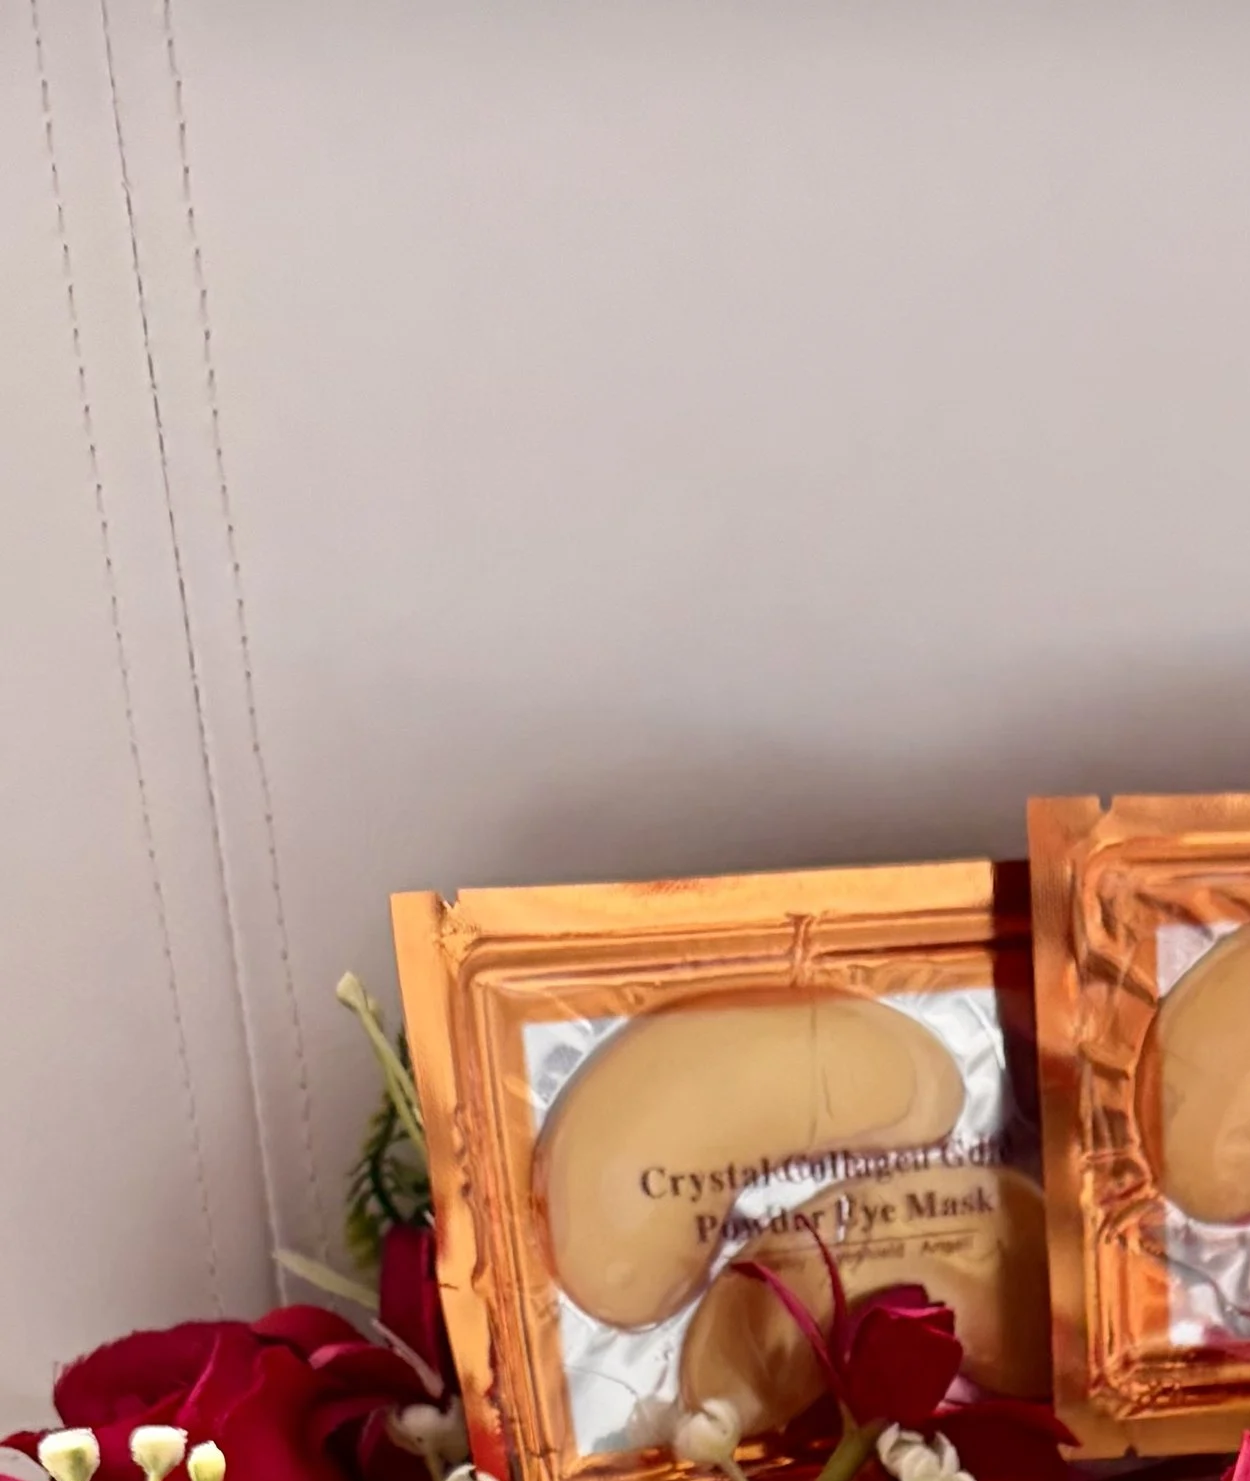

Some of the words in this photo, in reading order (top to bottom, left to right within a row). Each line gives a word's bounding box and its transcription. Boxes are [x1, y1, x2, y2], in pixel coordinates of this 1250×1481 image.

[641, 1156, 771, 1202] Crystal
[782, 1148, 930, 1184] Collagen
[906, 1187, 993, 1220] Mask
